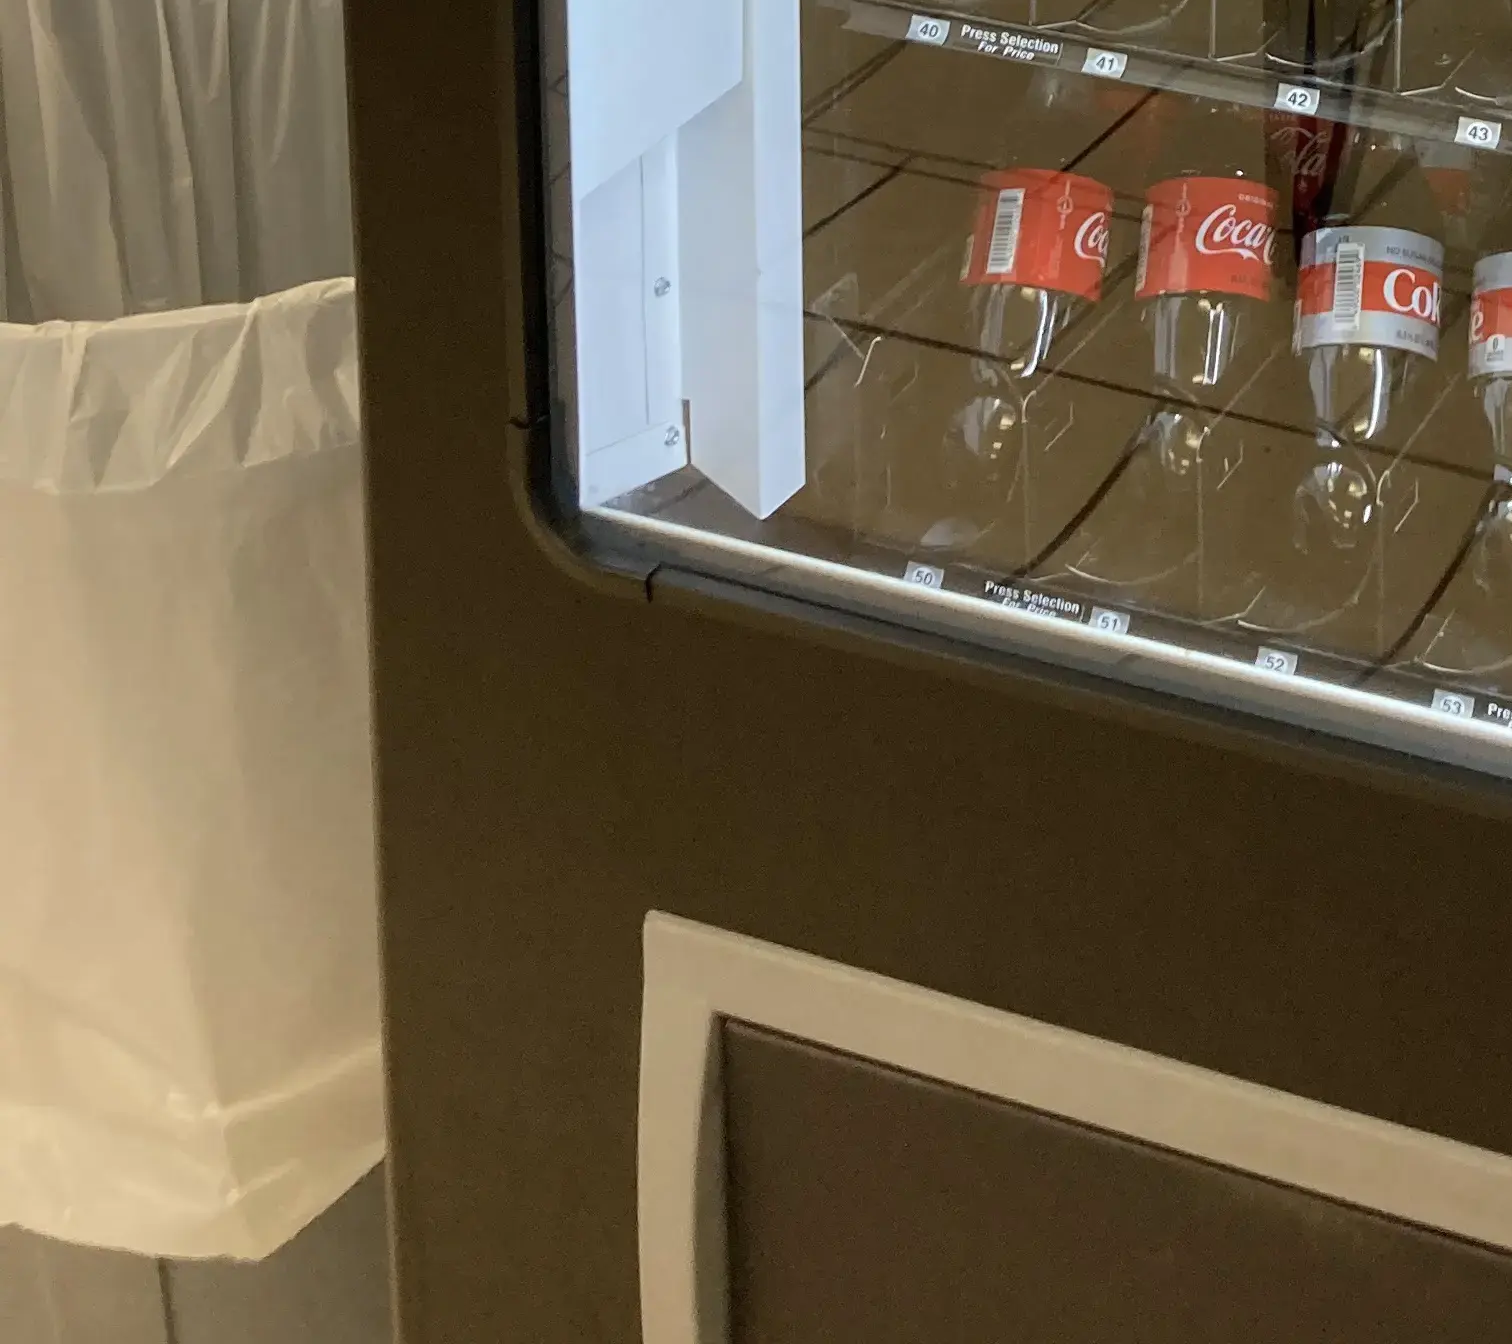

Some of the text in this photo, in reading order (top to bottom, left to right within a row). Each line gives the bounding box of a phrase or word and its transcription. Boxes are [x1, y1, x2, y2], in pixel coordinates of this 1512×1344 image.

[920, 23, 939, 38] 40
[961, 24, 1059, 54] Press Selection
[978, 41, 1034, 61] For Price
[1096, 56, 1116, 71] 41
[1288, 92, 1307, 107] 42
[1468, 125, 1489, 141] 43
[915, 571, 933, 585] 50
[984, 580, 1080, 614] Press Selection
[1100, 615, 1118, 630] 51
[1265, 656, 1285, 672] 52
